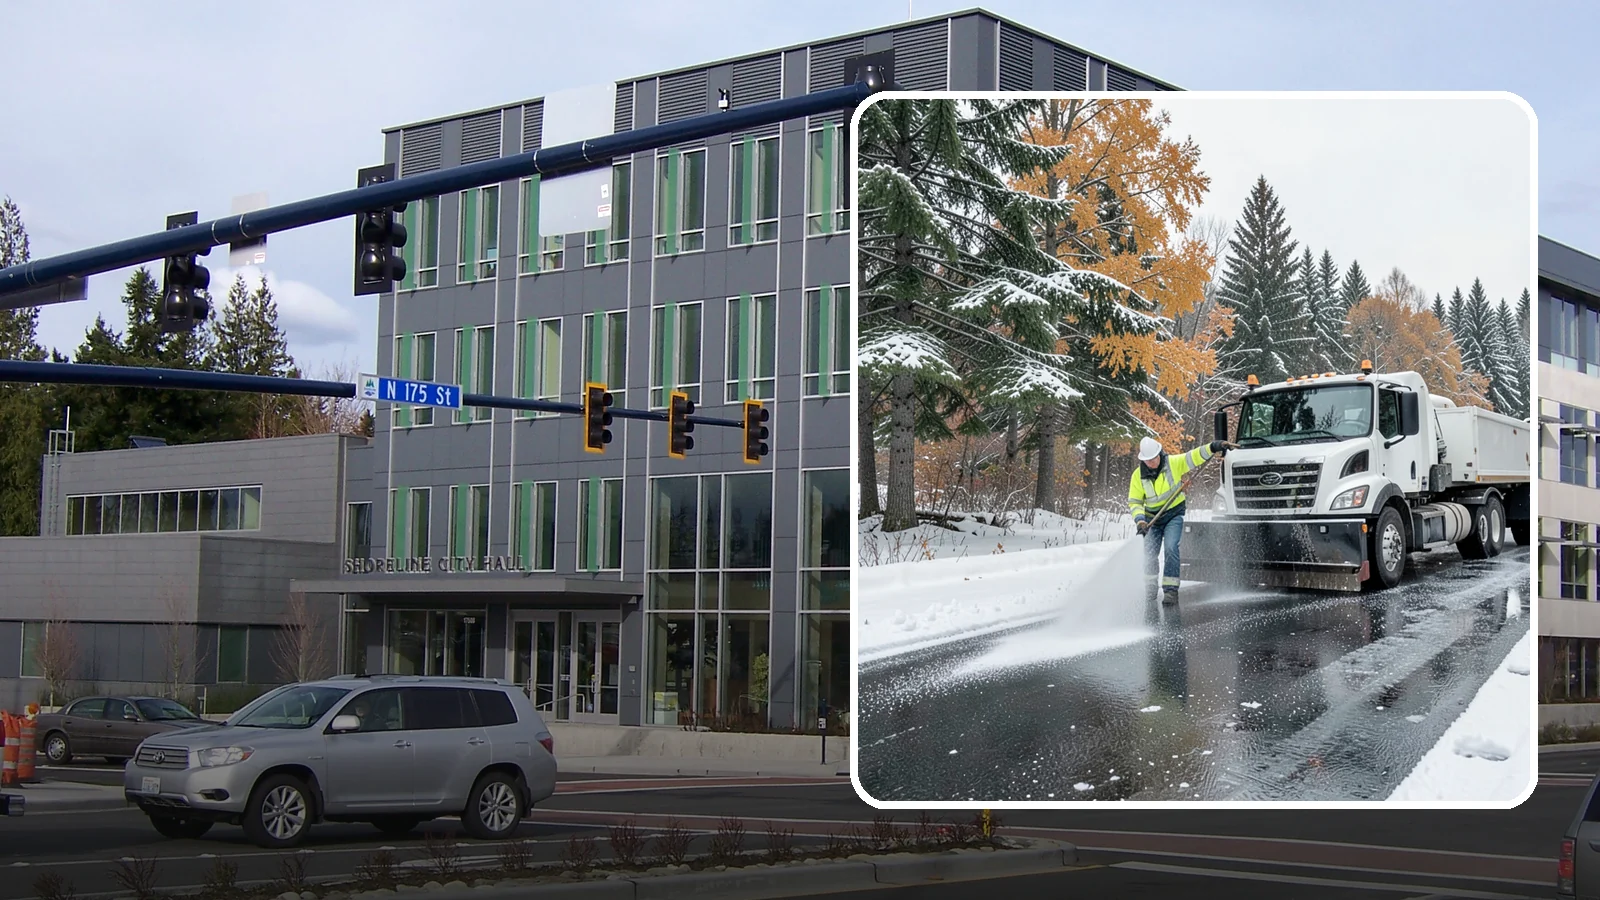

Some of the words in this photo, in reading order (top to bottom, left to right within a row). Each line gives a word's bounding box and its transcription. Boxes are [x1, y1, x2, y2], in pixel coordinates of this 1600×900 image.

[387, 380, 396, 400] N
[405, 383, 427, 403] 175
[436, 386, 451, 406] St
[344, 556, 431, 574] SHORELINE
[438, 556, 476, 572] CITY
[484, 555, 525, 572] HALL
